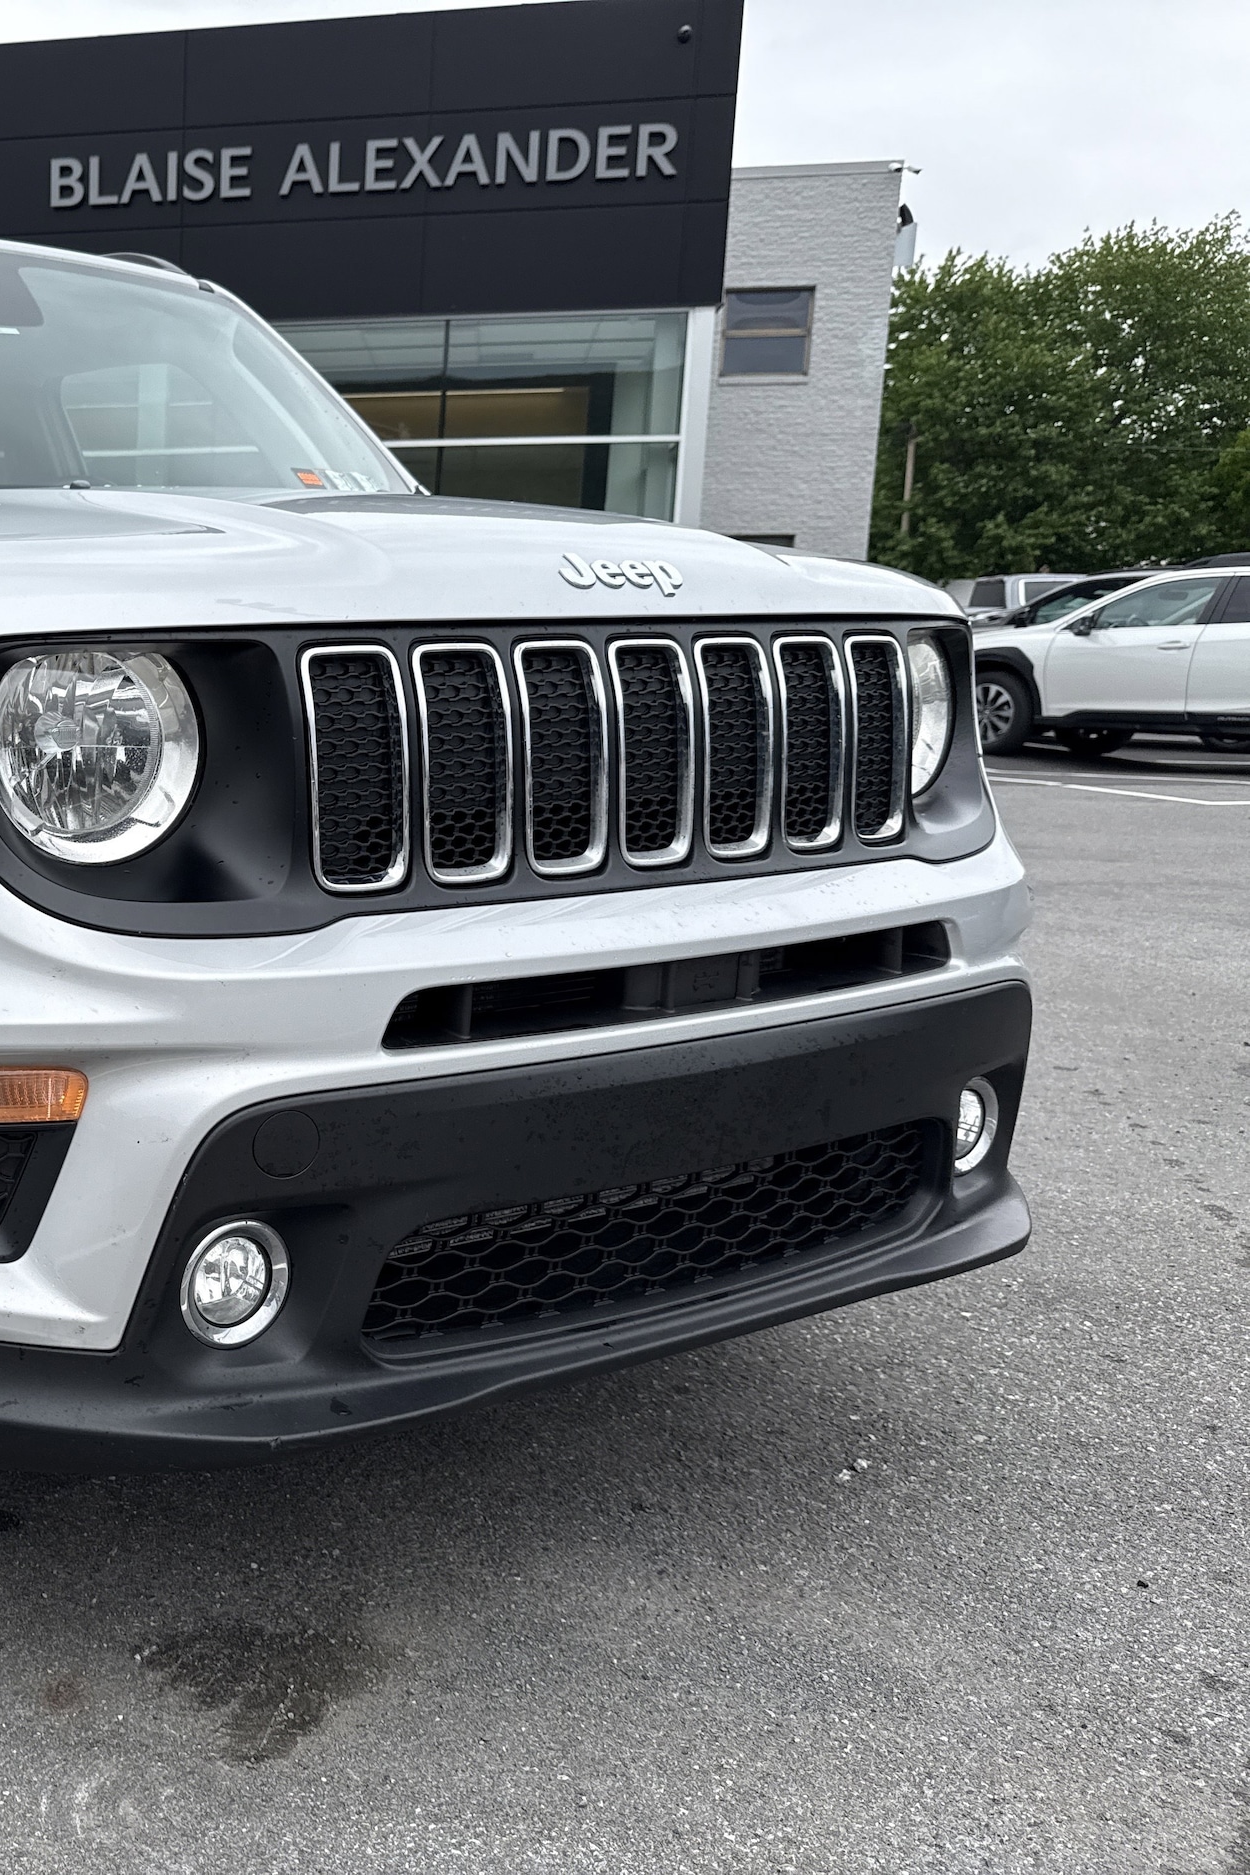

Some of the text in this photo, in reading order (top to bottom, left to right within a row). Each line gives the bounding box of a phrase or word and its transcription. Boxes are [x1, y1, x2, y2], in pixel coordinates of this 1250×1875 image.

[48, 122, 679, 208] BLAISE ALEXANDER
[558, 552, 683, 598] Jeep
